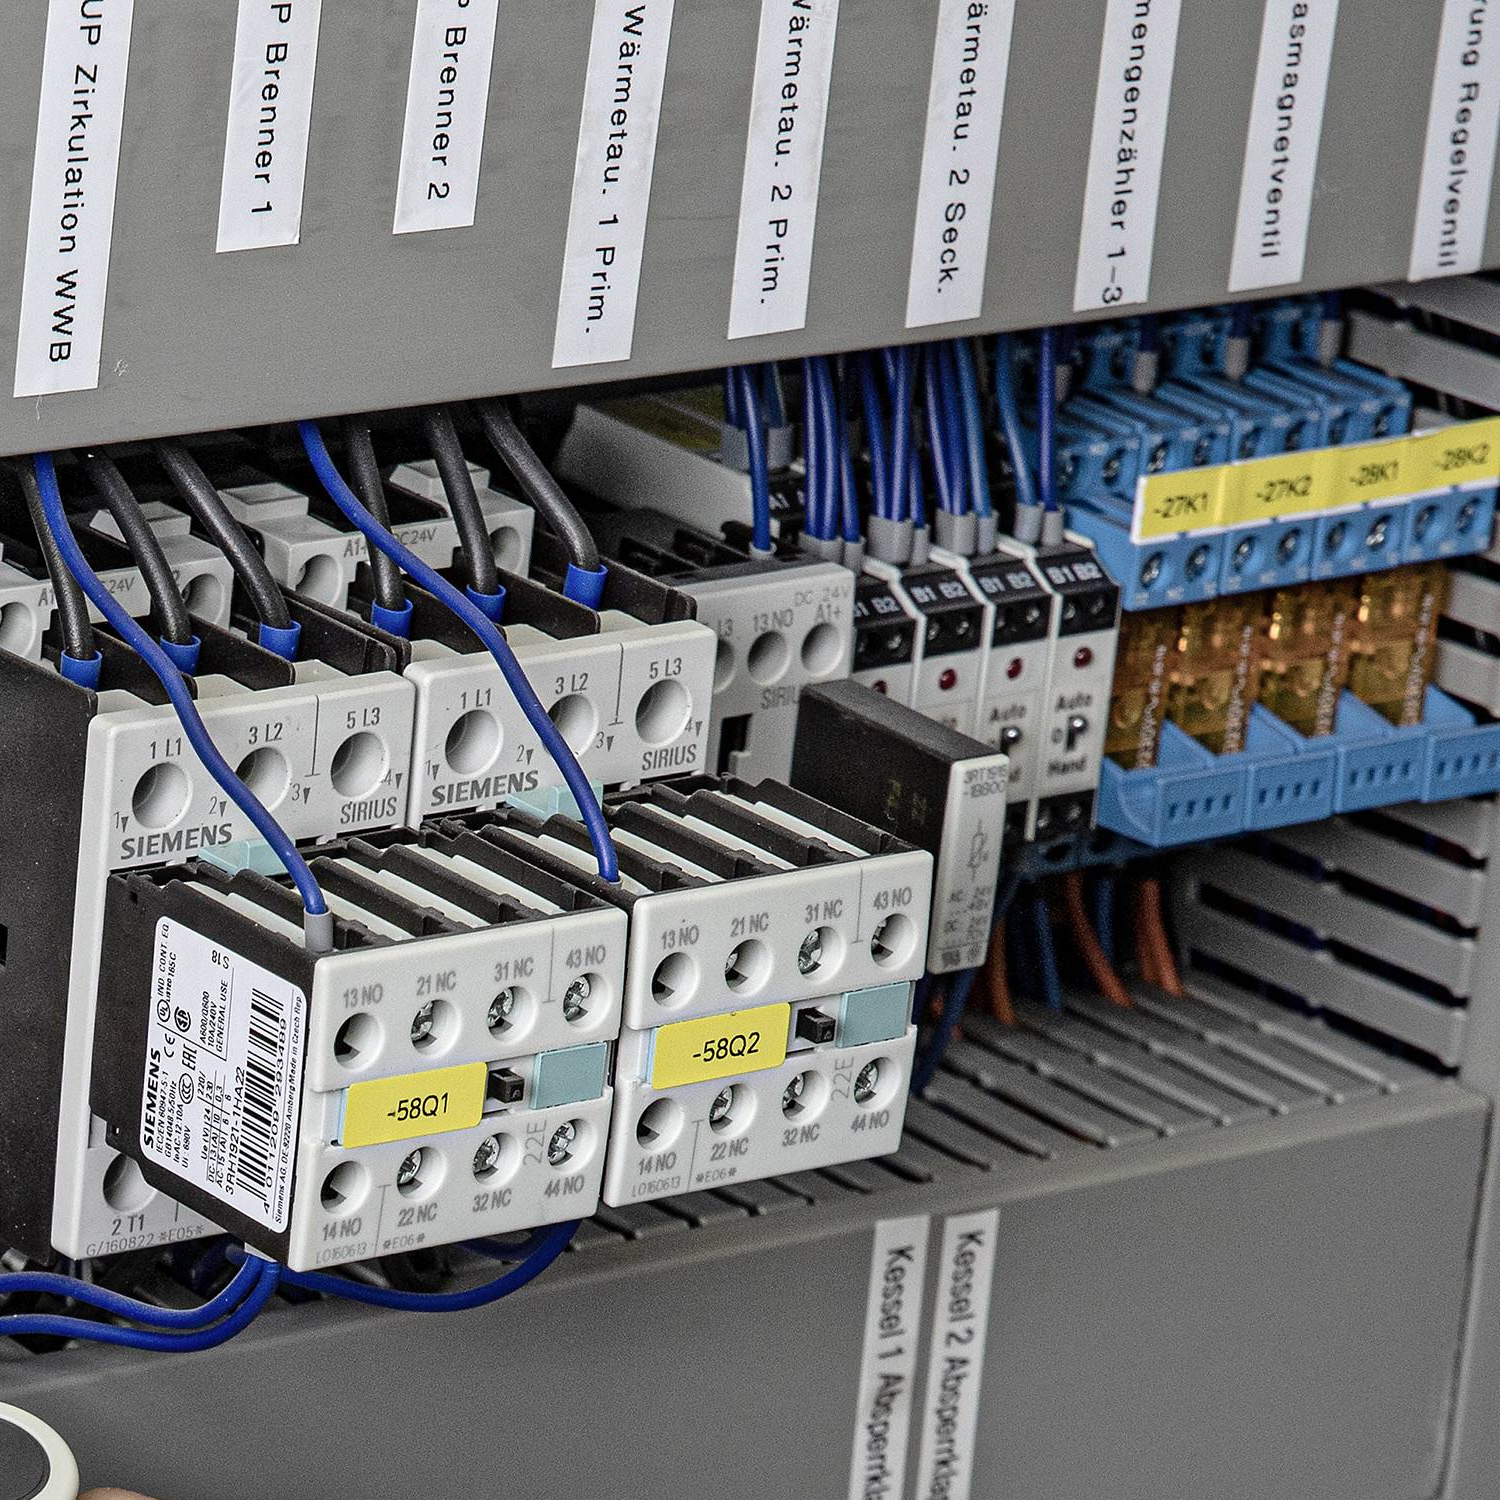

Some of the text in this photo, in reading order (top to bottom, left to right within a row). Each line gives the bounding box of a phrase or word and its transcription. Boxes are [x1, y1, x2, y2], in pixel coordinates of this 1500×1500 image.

[432, 26, 467, 170] Brenner
[251, 43, 289, 213] Brenner 1
[49, 0, 102, 363] UP Zirkulation WWB
[584, 4, 647, 334] Wärmetau. 1 Prim.
[949, 168, 971, 186] 2
[426, 182, 451, 200] 2
[770, 185, 793, 203] 2
[759, 218, 789, 304] Prim.
[937, 202, 967, 294] Seck.
[1102, 247, 1128, 304] 1-3
[642, 745, 696, 771] SIRIUS
[431, 771, 539, 806] SIEMENS
[340, 797, 396, 824] SIRIUS
[120, 823, 233, 860] SIEMENS
[494, 958, 534, 981] 31 NC
[567, 945, 606, 968] 43 NO
[216, 980, 228, 1052] GENERAL USE
[692, 1032, 760, 1063] -58Q2
[144, 1048, 161, 1148] SIEMENS
[387, 1093, 449, 1121] -58Q1
[878, 1246, 914, 1339] Kessel
[949, 1230, 984, 1321] Kessel
[946, 1329, 974, 1347] 2
